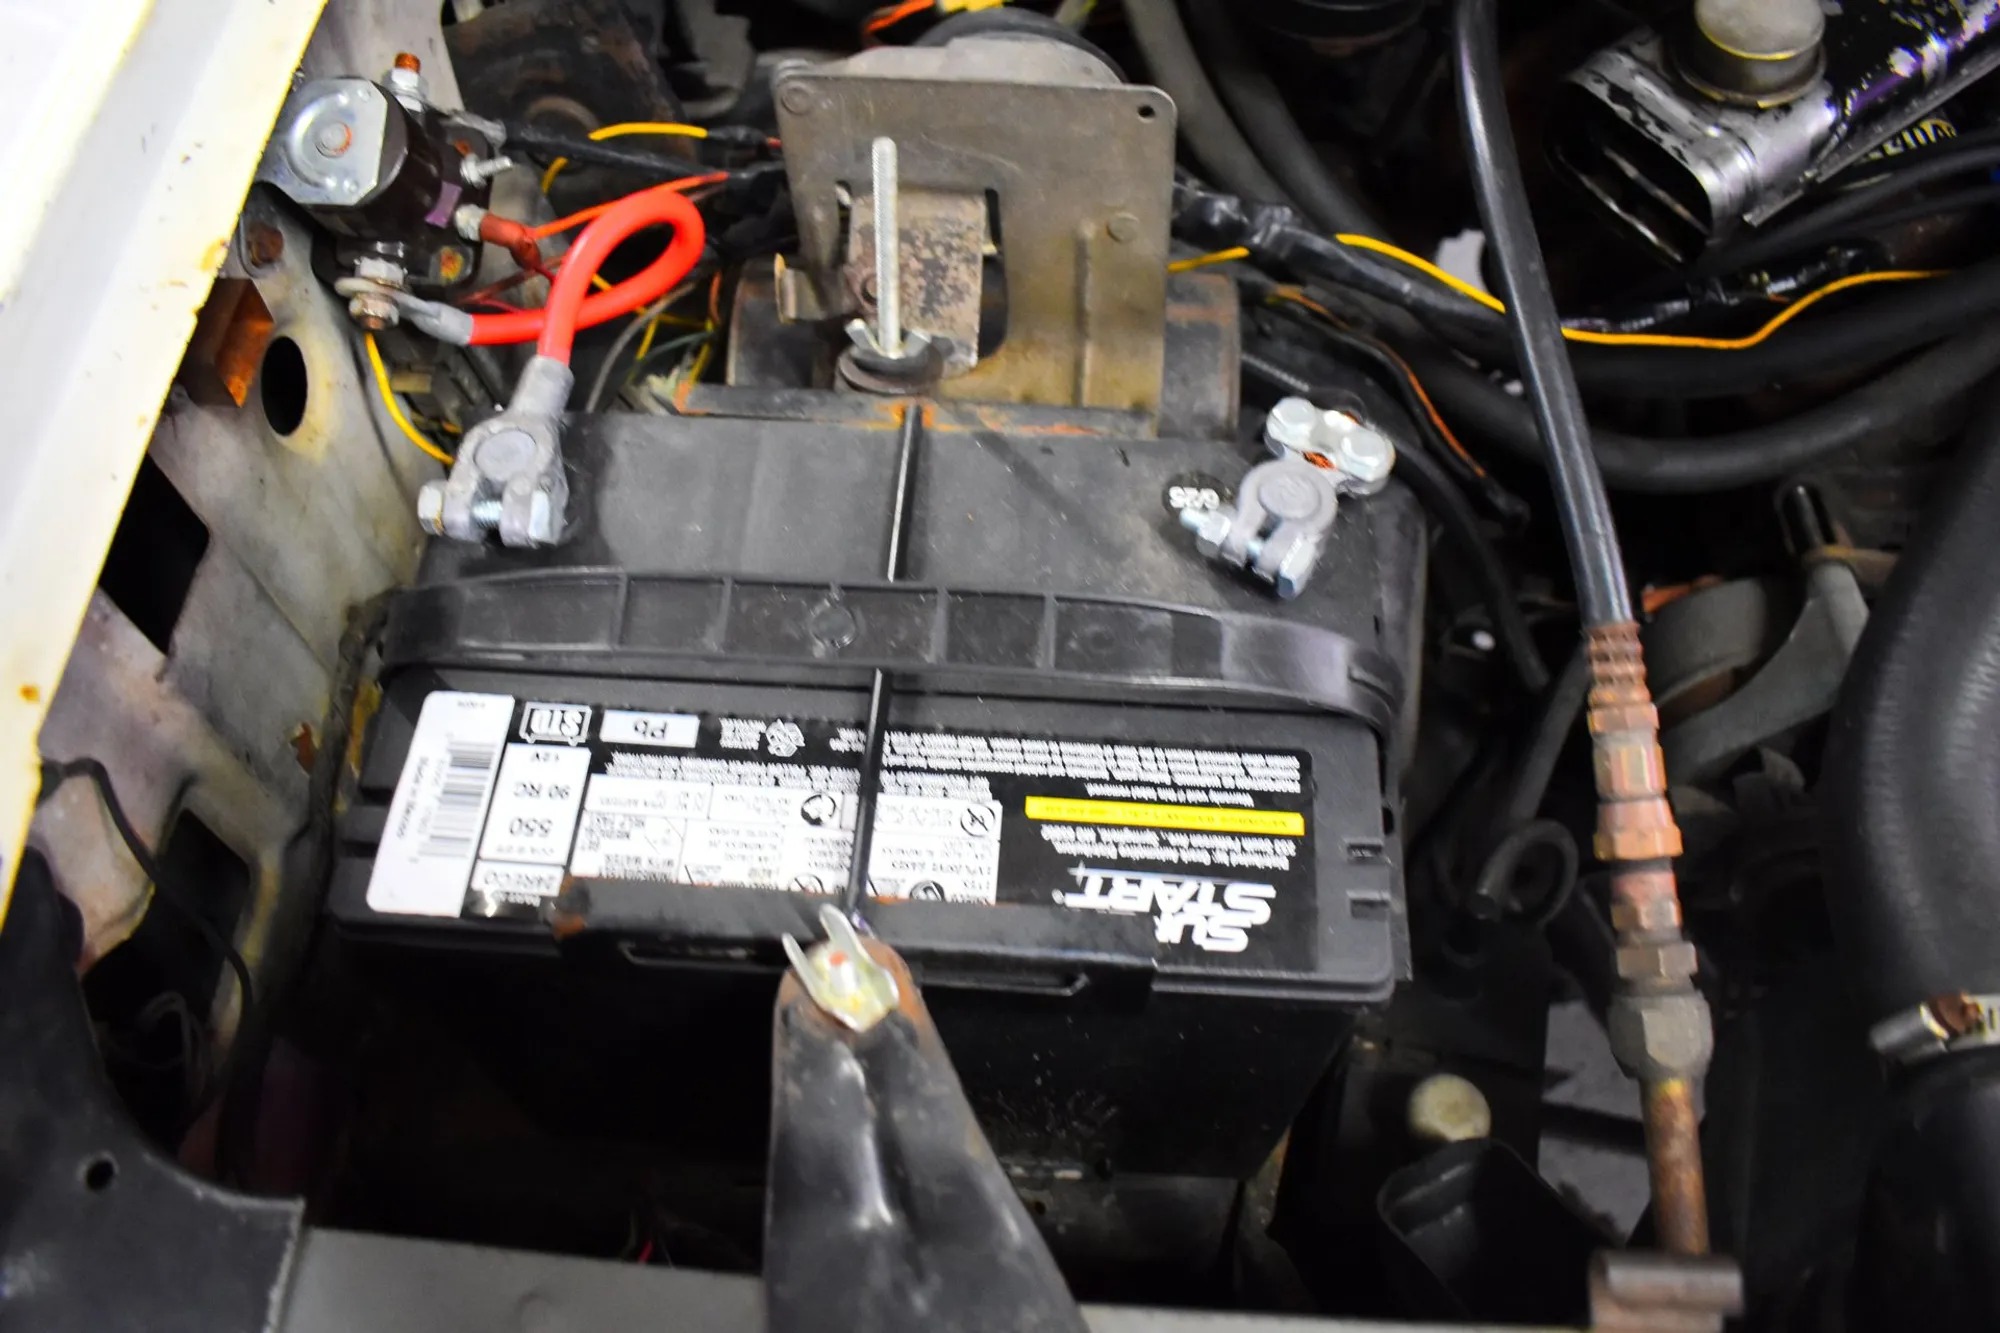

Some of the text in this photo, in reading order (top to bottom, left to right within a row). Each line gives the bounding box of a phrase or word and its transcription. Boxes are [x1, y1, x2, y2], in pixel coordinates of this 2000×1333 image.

[633, 720, 667, 740] Pb
[513, 782, 570, 801] 90 RC
[509, 818, 552, 838] 550
[1064, 874, 1277, 926] START
